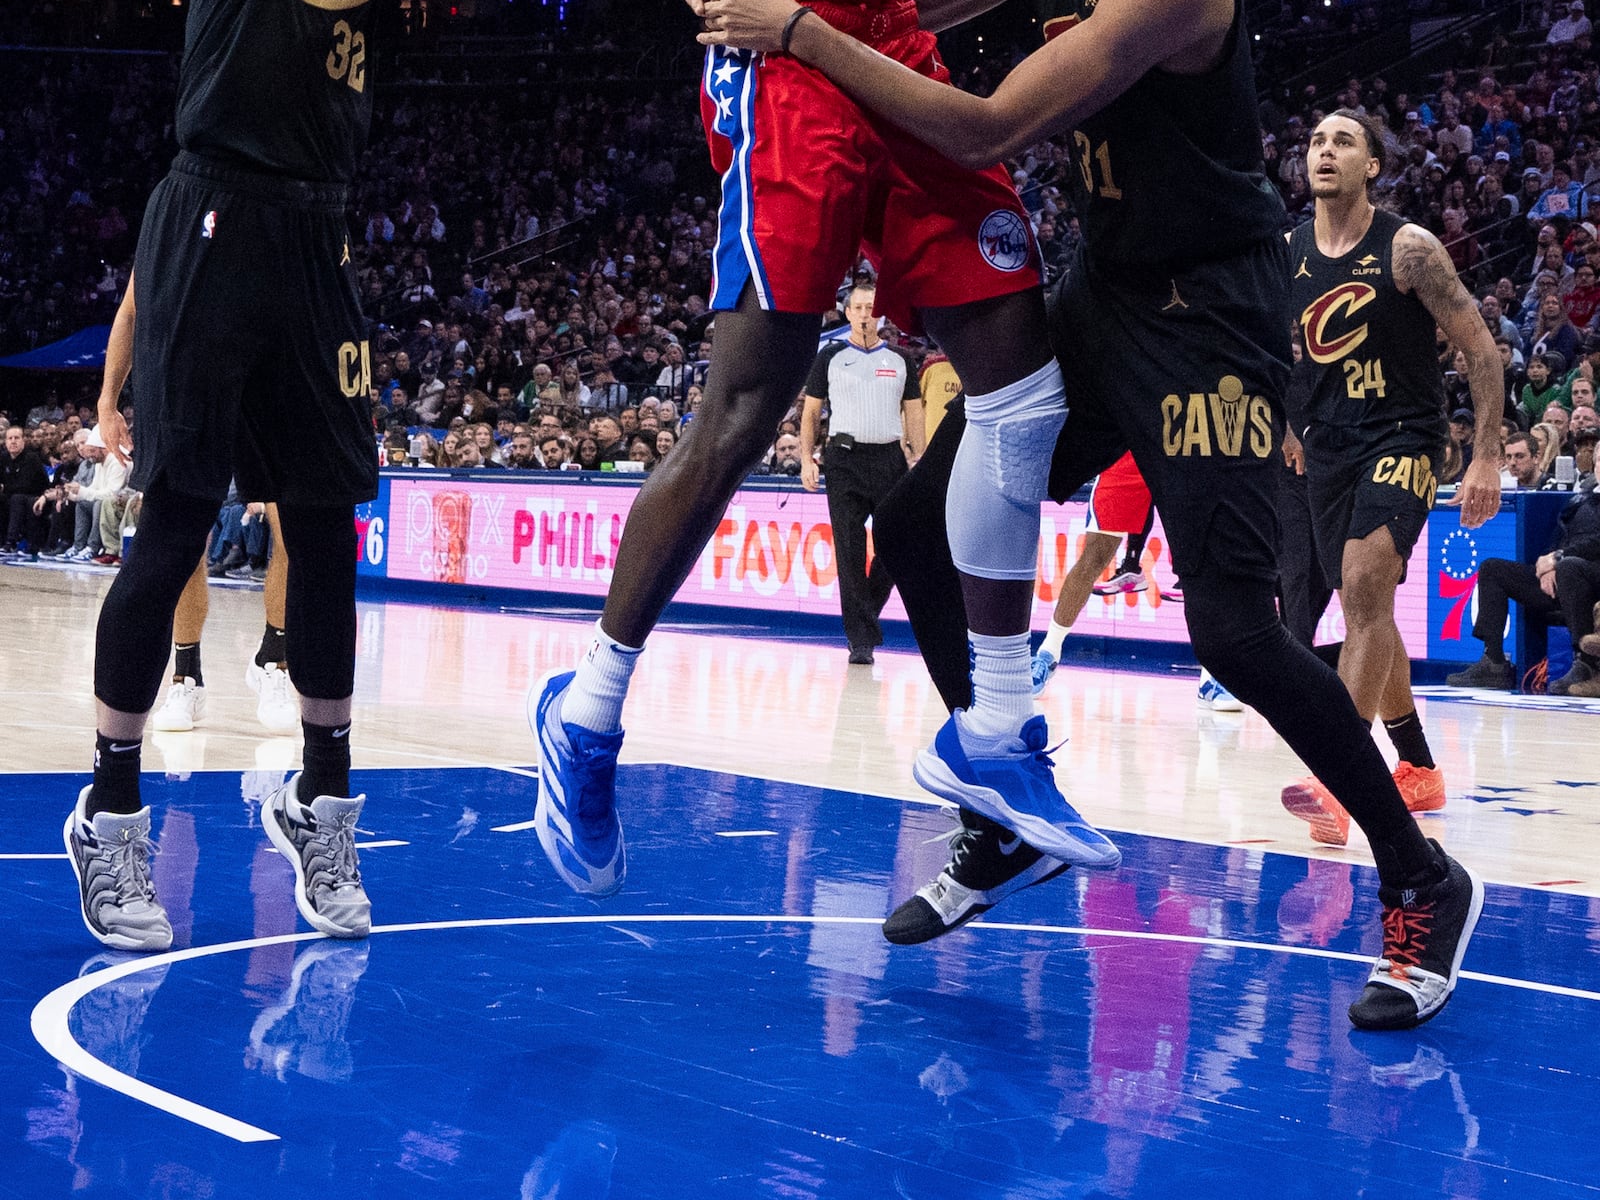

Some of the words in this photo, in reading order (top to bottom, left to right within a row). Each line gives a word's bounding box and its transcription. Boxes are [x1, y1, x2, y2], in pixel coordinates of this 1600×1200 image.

[326, 19, 365, 94] 32
[1073, 130, 1122, 201] 31
[1352, 266, 1381, 276] CLIFFS
[1343, 358, 1386, 400] 24
[1161, 392, 1272, 458] CAVS
